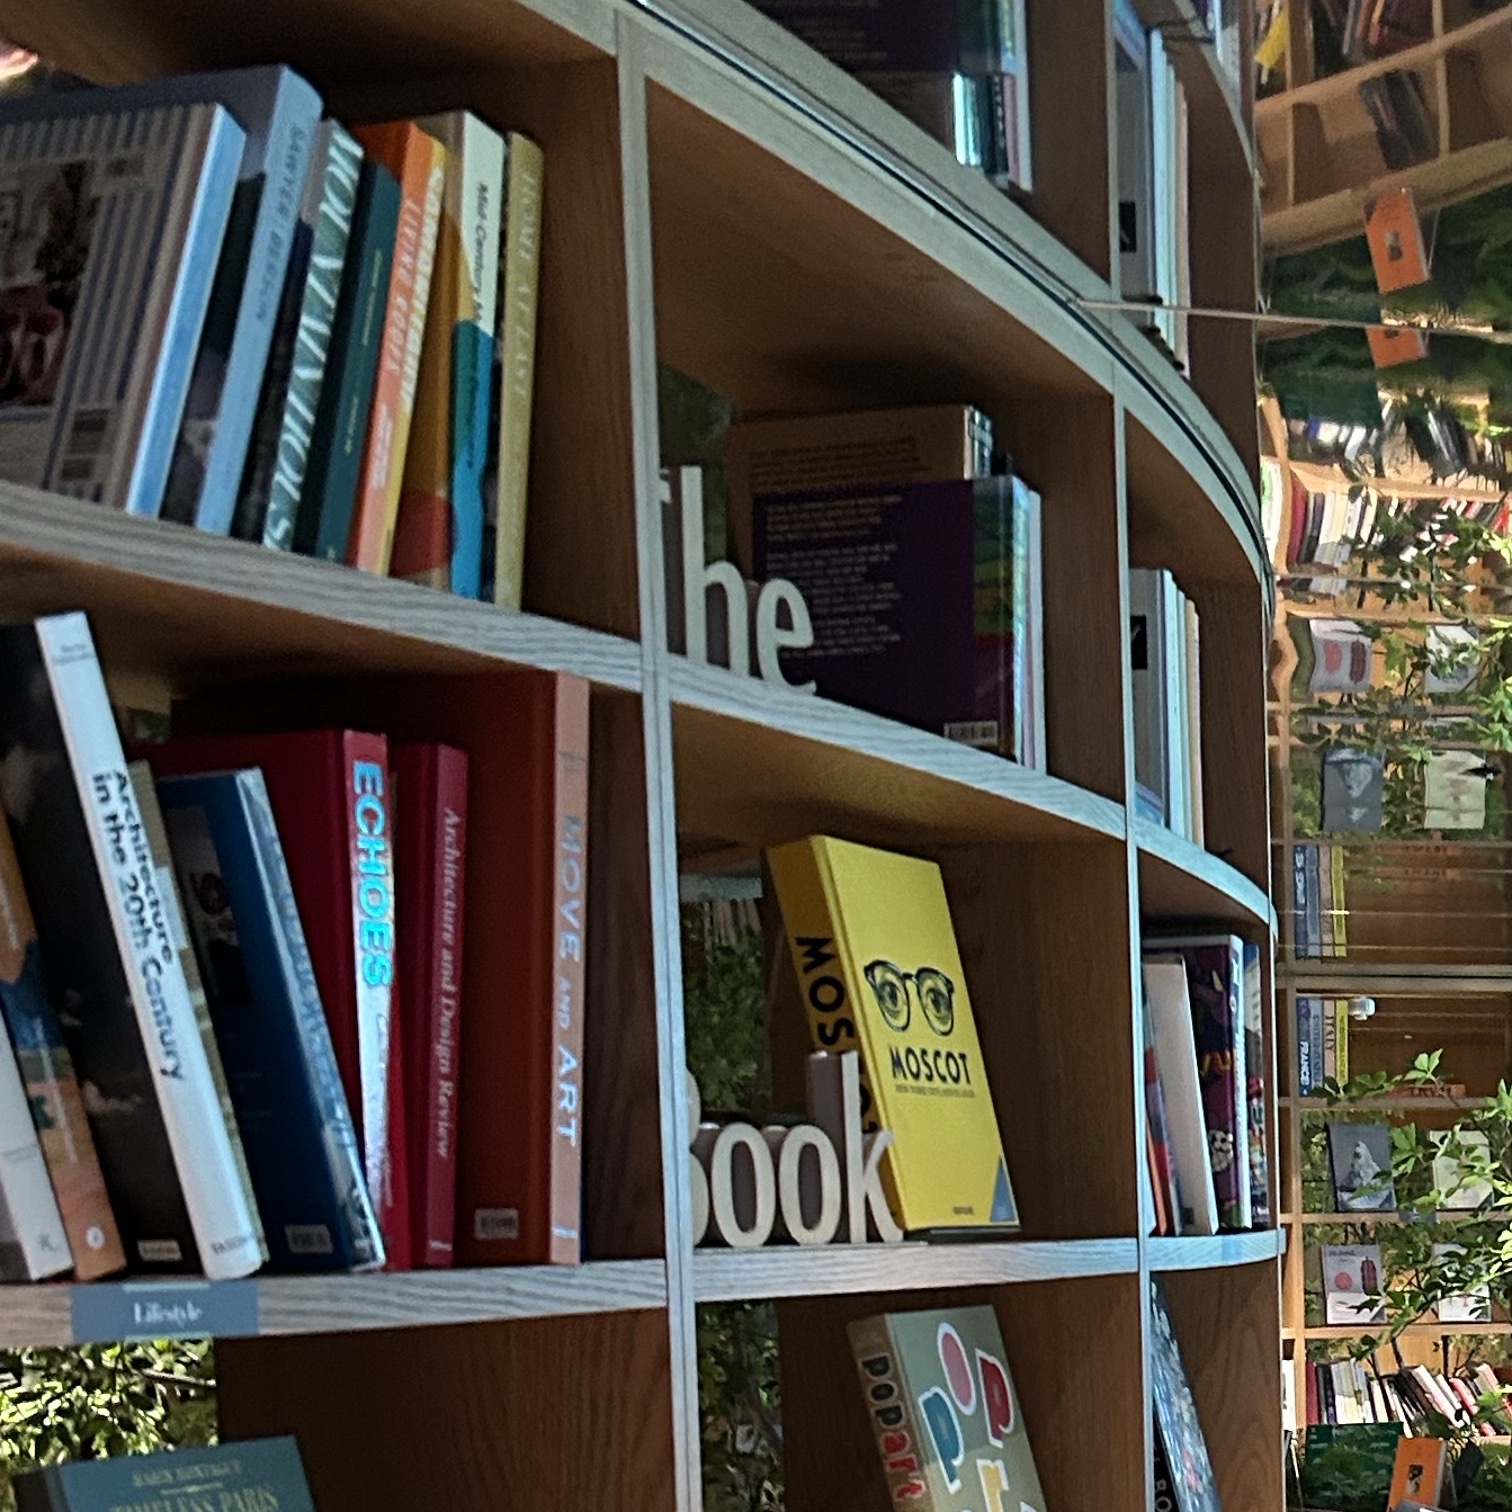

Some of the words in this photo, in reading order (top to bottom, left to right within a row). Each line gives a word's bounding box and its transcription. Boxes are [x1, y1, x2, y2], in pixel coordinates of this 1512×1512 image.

[658, 465, 817, 695] he
[113, 771, 172, 964] Architecture
[353, 761, 394, 986] ECHOES
[443, 808, 462, 945] Architecture
[560, 815, 582, 962] MOVE
[93, 773, 110, 802] in
[105, 814, 125, 864] the
[118, 872, 153, 949] 20th
[142, 957, 183, 1081] Century
[441, 949, 457, 991] and
[559, 976, 571, 1030] AND
[437, 997, 455, 1074] Design
[889, 1046, 971, 1085] MOSCOT
[1300, 1041, 1310, 1086] FRANCE
[1325, 1015, 1334, 1050] ITALY
[437, 1080, 454, 1159] Review
[557, 1046, 578, 1148] ART
[134, 1301, 202, 1326] Lifestyle
[861, 1354, 904, 1428] pop
[881, 1430, 927, 1500] art
